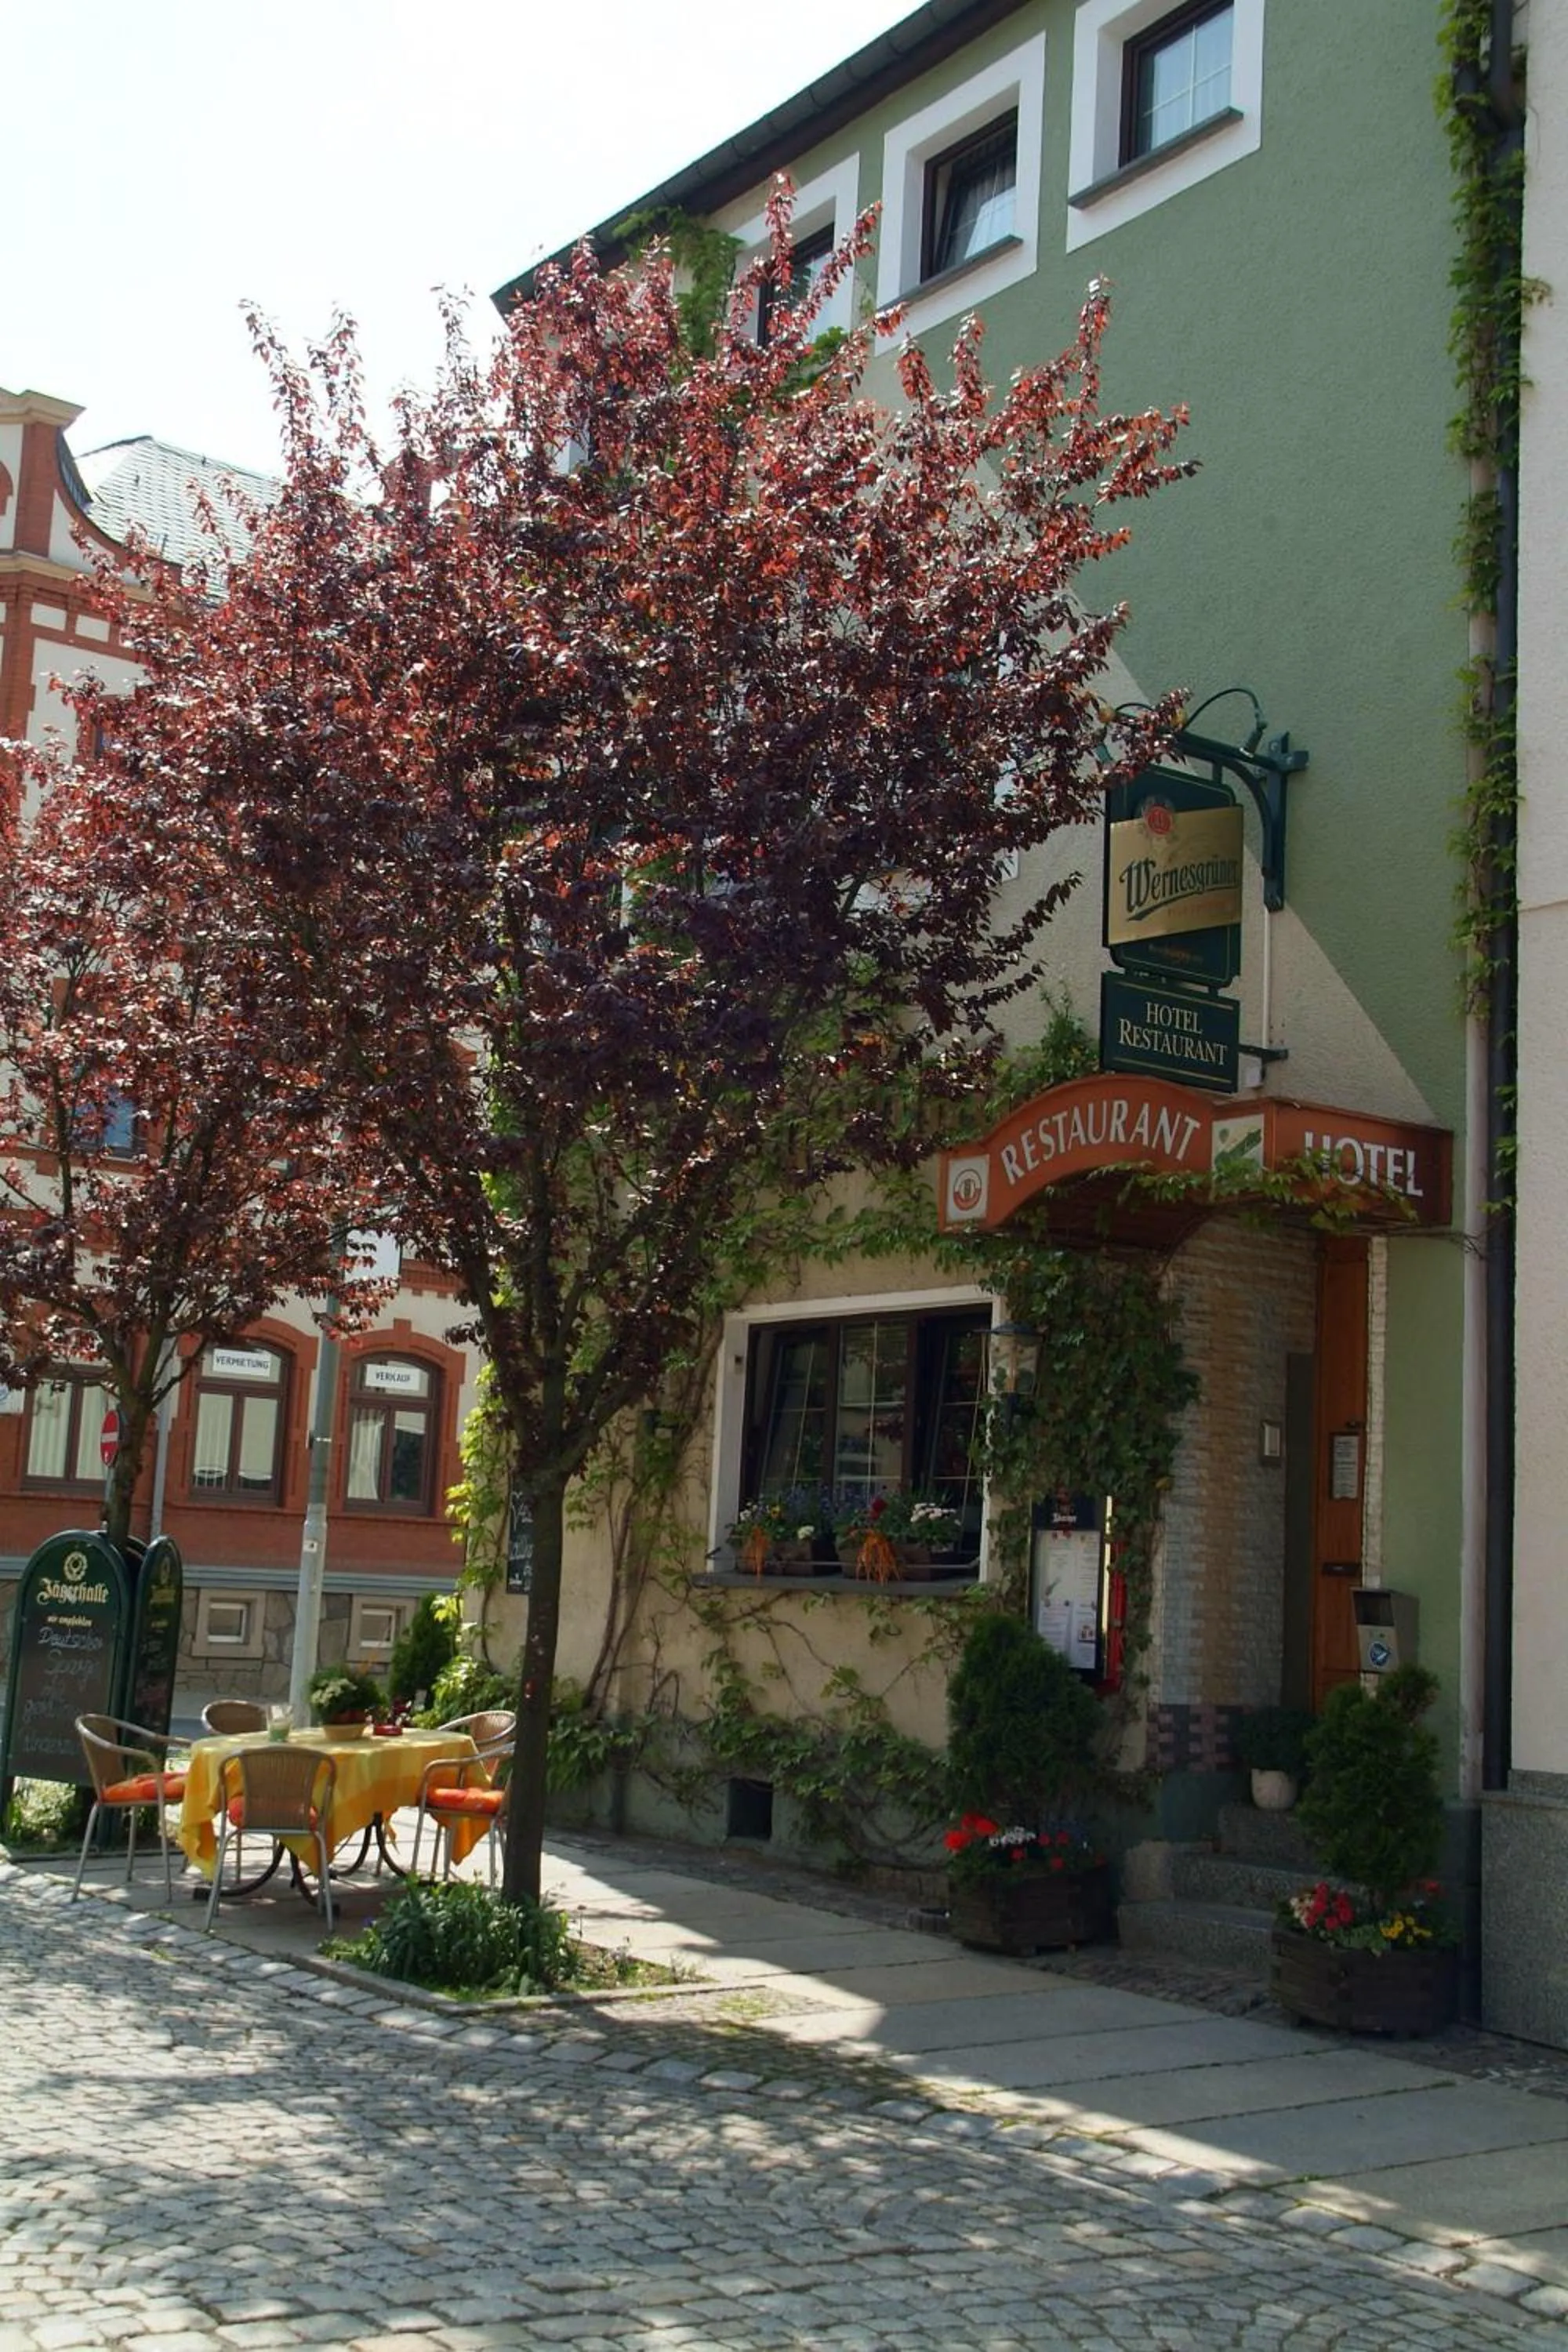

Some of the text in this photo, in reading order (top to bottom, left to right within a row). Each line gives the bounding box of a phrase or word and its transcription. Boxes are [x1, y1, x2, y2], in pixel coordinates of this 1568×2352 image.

[1145, 1001, 1203, 1034] HOTEL
[1119, 1018, 1228, 1065] RESTAURANT
[1000, 1099, 1201, 1185] RESTAURANT
[1304, 1131, 1424, 1197] HOTEL
[216, 1356, 270, 1370] VERMIETUNG
[376, 1371, 412, 1383] VERKAUF
